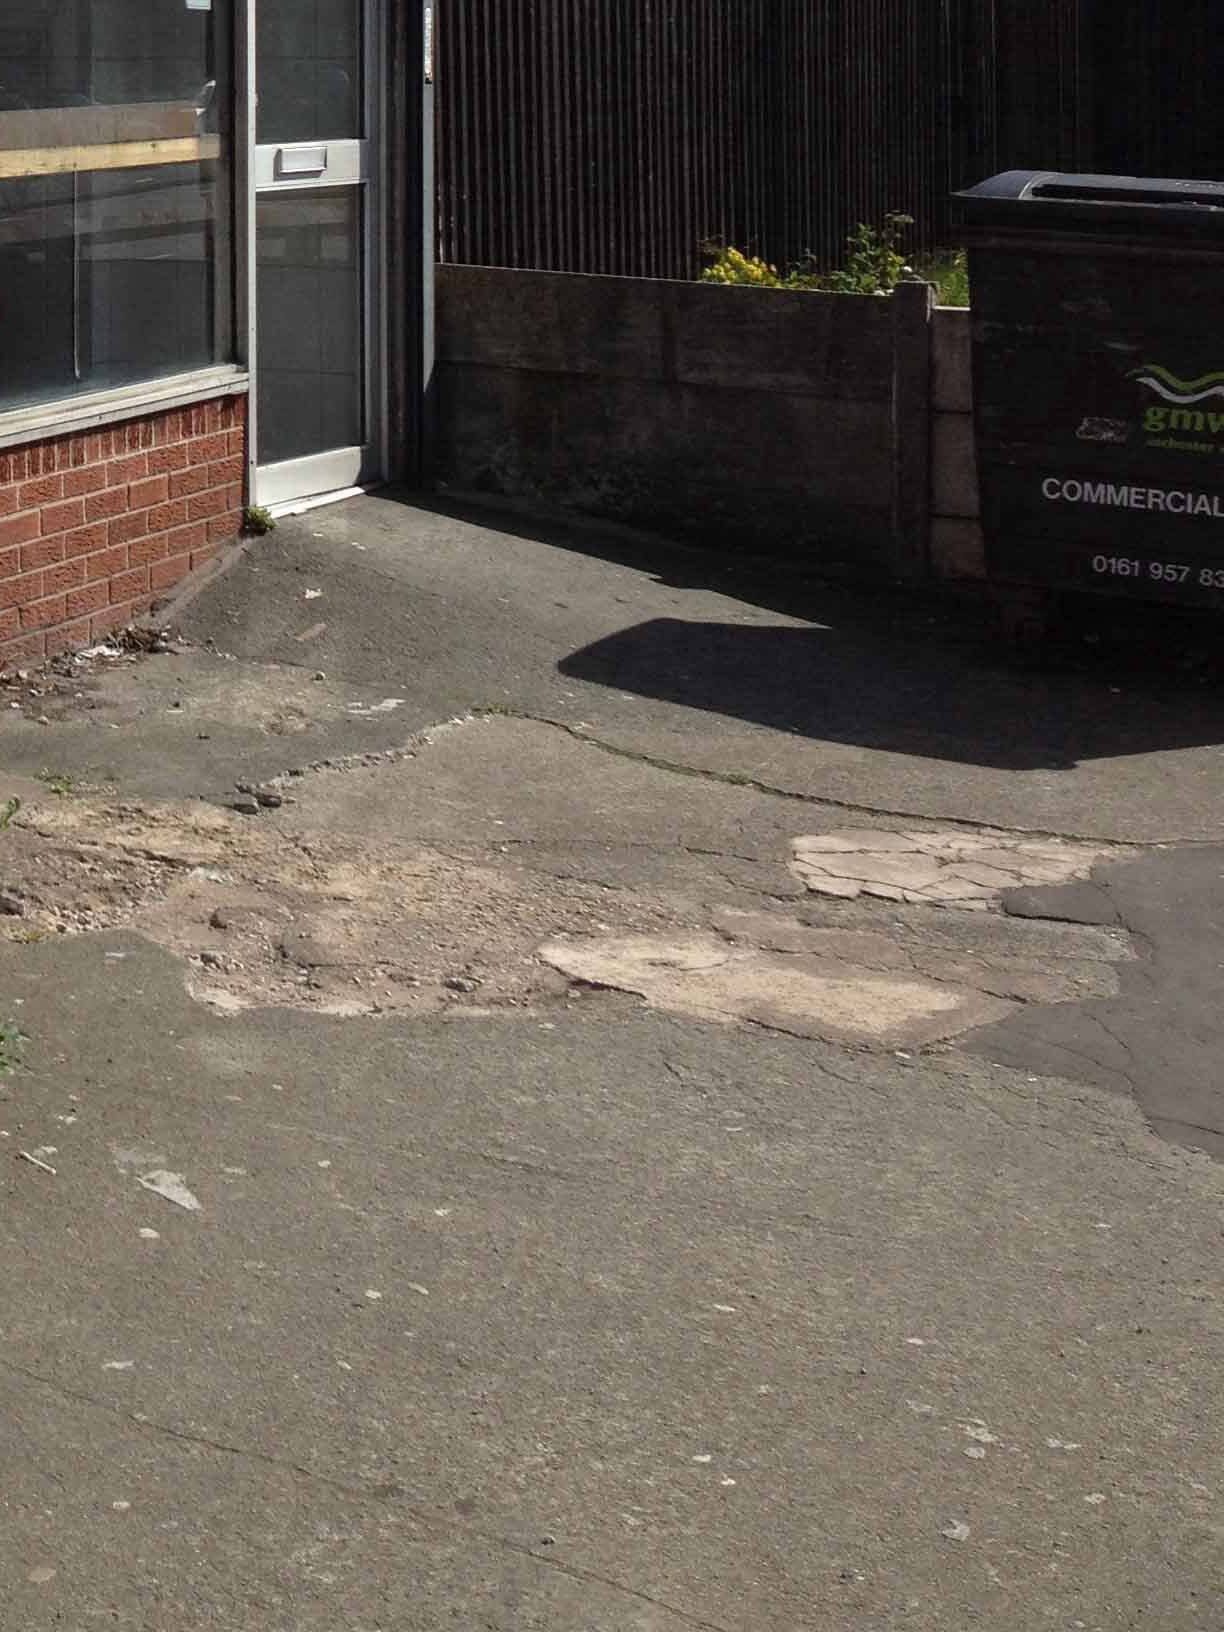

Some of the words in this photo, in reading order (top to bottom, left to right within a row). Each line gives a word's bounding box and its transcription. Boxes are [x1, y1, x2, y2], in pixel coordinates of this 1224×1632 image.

[1041, 477, 1224, 518] COMMERCIAL
[1092, 555, 1139, 577] 0161
[1149, 562, 1191, 583] 957
